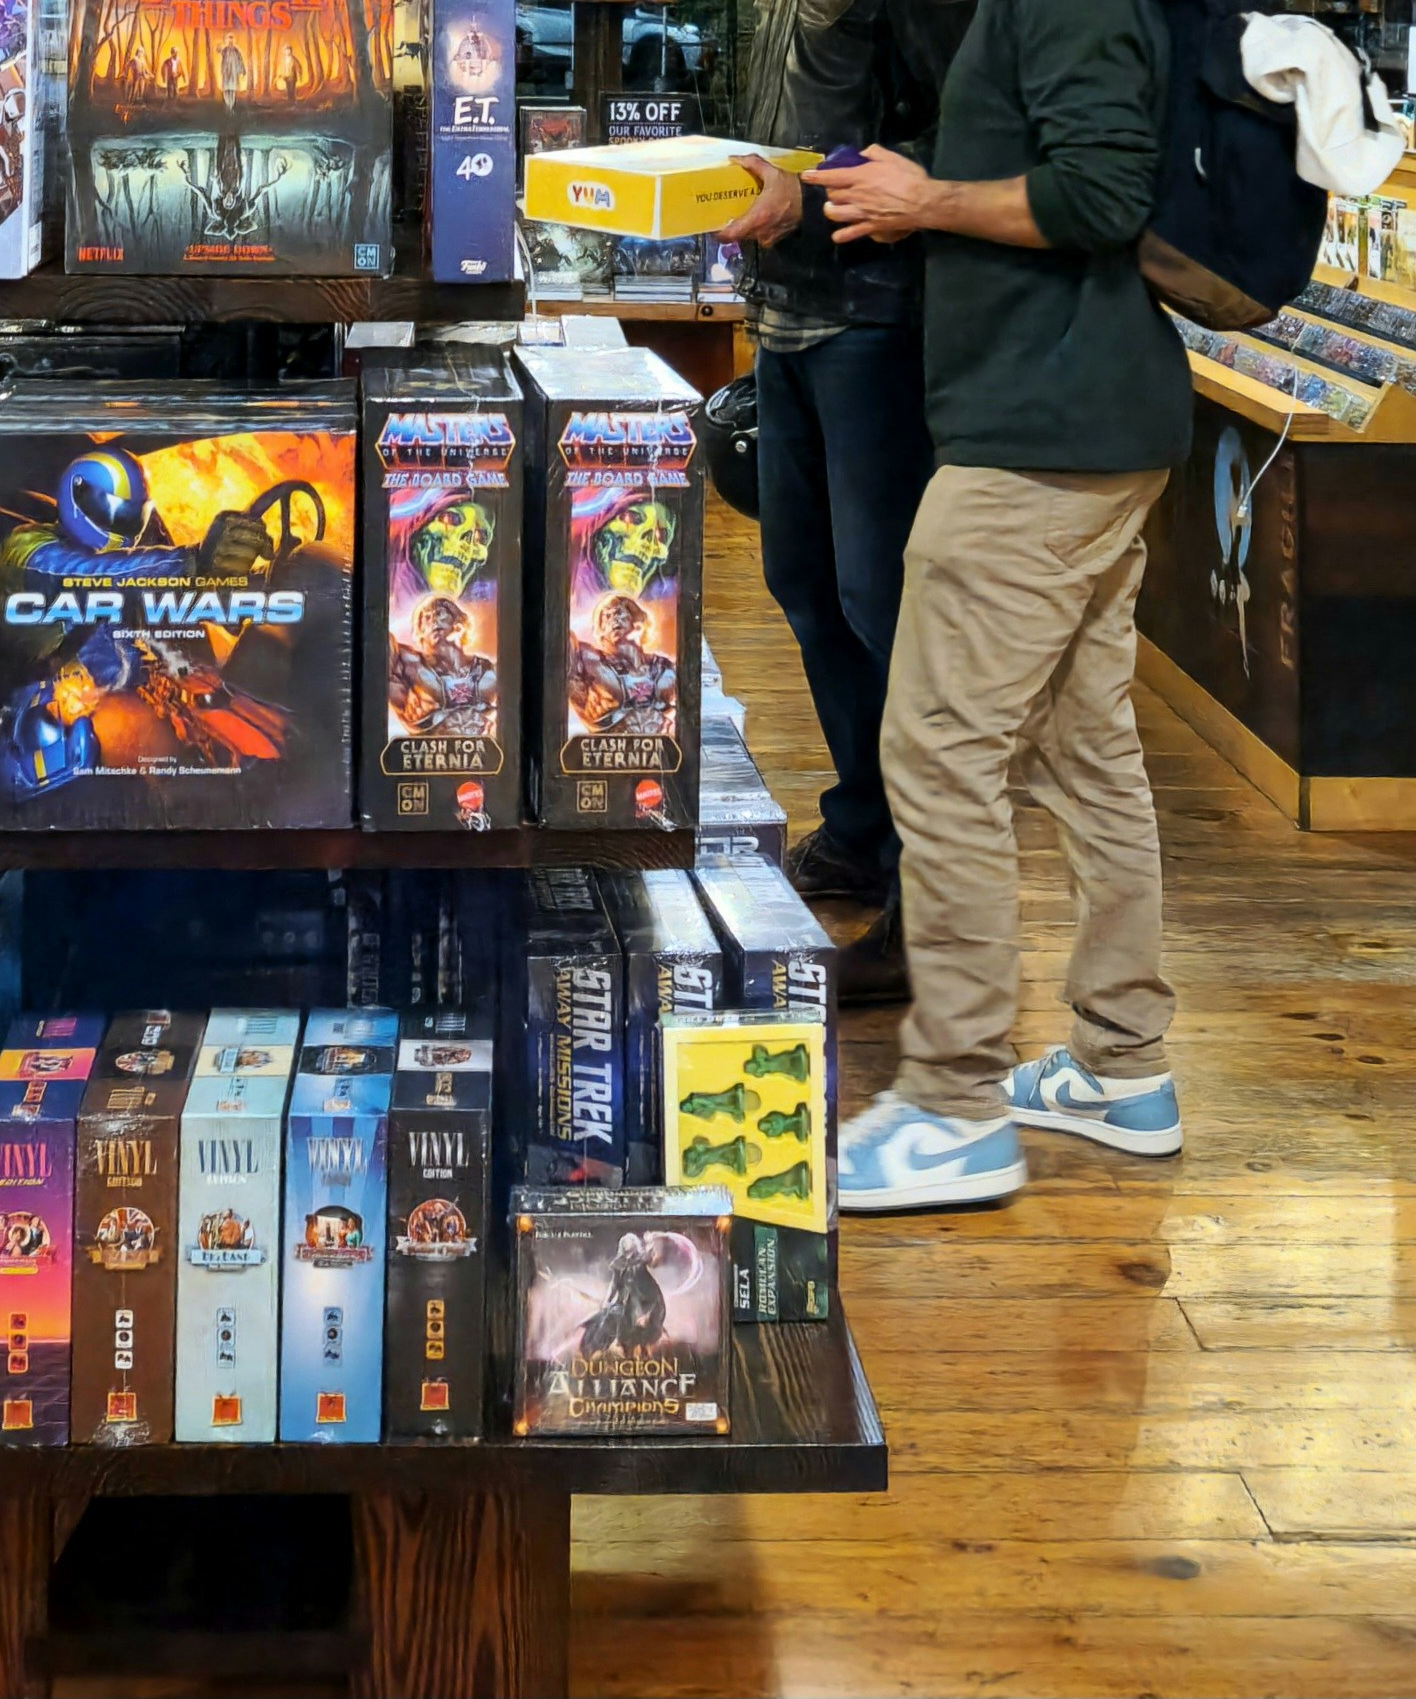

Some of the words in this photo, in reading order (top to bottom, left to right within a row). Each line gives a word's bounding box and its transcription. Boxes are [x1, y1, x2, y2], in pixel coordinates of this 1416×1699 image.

[172, 0, 293, 30] THINGS
[454, 97, 499, 125] E.T.
[610, 103, 641, 121] 13%
[645, 103, 682, 121] OFF
[609, 126, 630, 137] OUR
[634, 125, 683, 136] FAVORITE
[572, 184, 611, 208] YUM
[696, 193, 712, 203] YOU
[713, 189, 748, 201] DESERVE
[78, 246, 124, 263] NETFLIX
[378, 412, 514, 445] MASTERS
[561, 411, 694, 444] MASTERS
[408, 448, 431, 456] THE
[590, 447, 613, 456] THE
[384, 473, 408, 486] THE
[412, 473, 462, 486] BOARD
[466, 472, 506, 486] GAME
[566, 472, 591, 486] THE
[594, 472, 644, 485] BOARD
[647, 471, 687, 485] GAME
[63, 577, 113, 588] STEVE
[116, 577, 191, 588] JACKSON
[195, 577, 248, 588] GAMES
[5, 591, 125, 625] CAR
[143, 590, 307, 625] WARS
[112, 629, 151, 640] SIXTH
[154, 629, 205, 640] EDITION
[400, 740, 447, 753] CLASH
[454, 740, 486, 753] FOR
[581, 739, 626, 752] CLASH
[634, 738, 664, 751] FOR
[137, 755, 169, 764] Designed
[402, 754, 483, 771] ETERNIA
[582, 752, 662, 767] ETERNIA
[73, 767, 93, 775] Sam
[95, 766, 137, 775] Mitschke
[139, 767, 147, 775] &
[149, 766, 177, 777] Randy
[658, 963, 673, 1013] AWA
[772, 959, 787, 1008] AWA
[556, 965, 572, 1029] AWAY
[572, 968, 612, 1052] STAR
[556, 1035, 572, 1141] MISSIONS
[573, 1063, 613, 1145] TREK
[96, 1139, 158, 1175] VINYL
[198, 1138, 260, 1174] VINYL
[307, 1137, 368, 1175] VINYL
[409, 1132, 470, 1168] VINYL
[422, 1168, 453, 1179] EDITION
[740, 1268, 750, 1310] SELA
[571, 1356, 678, 1377] DUNGEON
[548, 1371, 696, 1398] ALLIANCE
